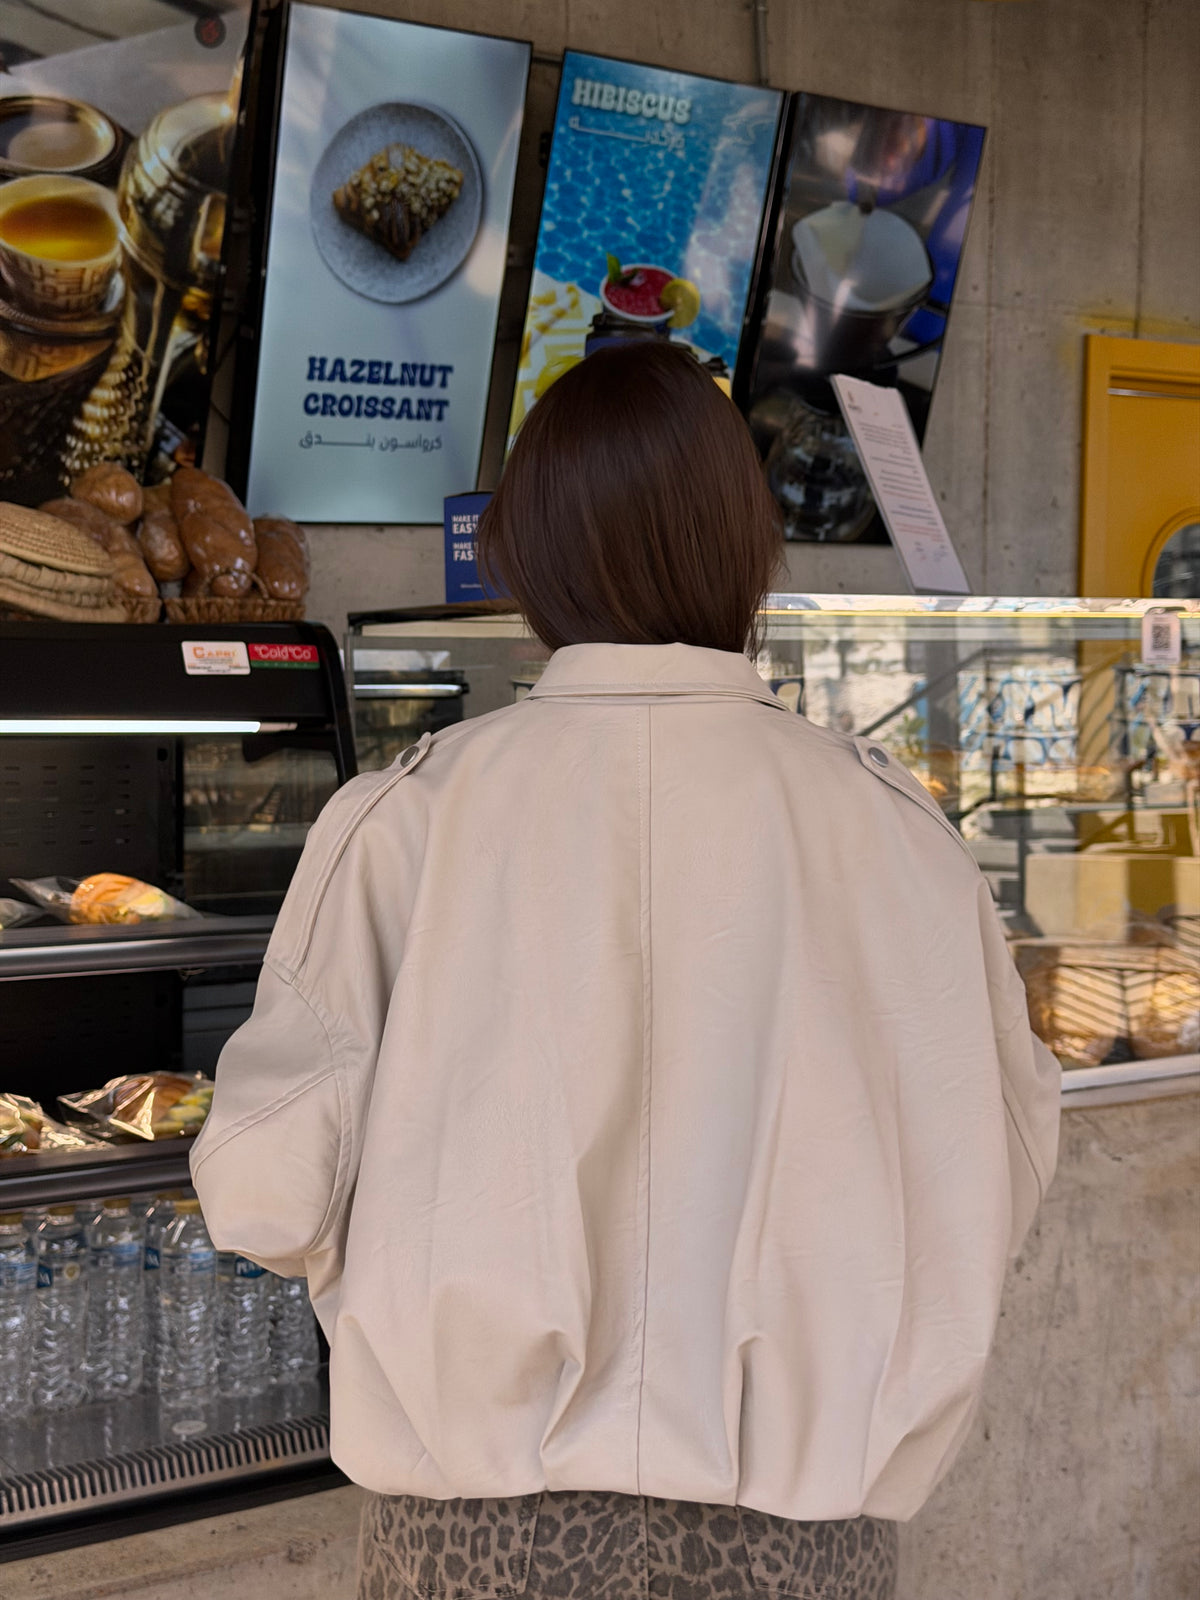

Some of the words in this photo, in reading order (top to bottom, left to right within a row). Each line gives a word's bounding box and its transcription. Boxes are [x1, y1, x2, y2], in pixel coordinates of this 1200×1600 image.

[572, 78, 693, 124] HIBISCUS
[306, 356, 454, 389] HAZELNUT
[303, 392, 449, 422] CROISSANT
[454, 550, 475, 561] FAS
